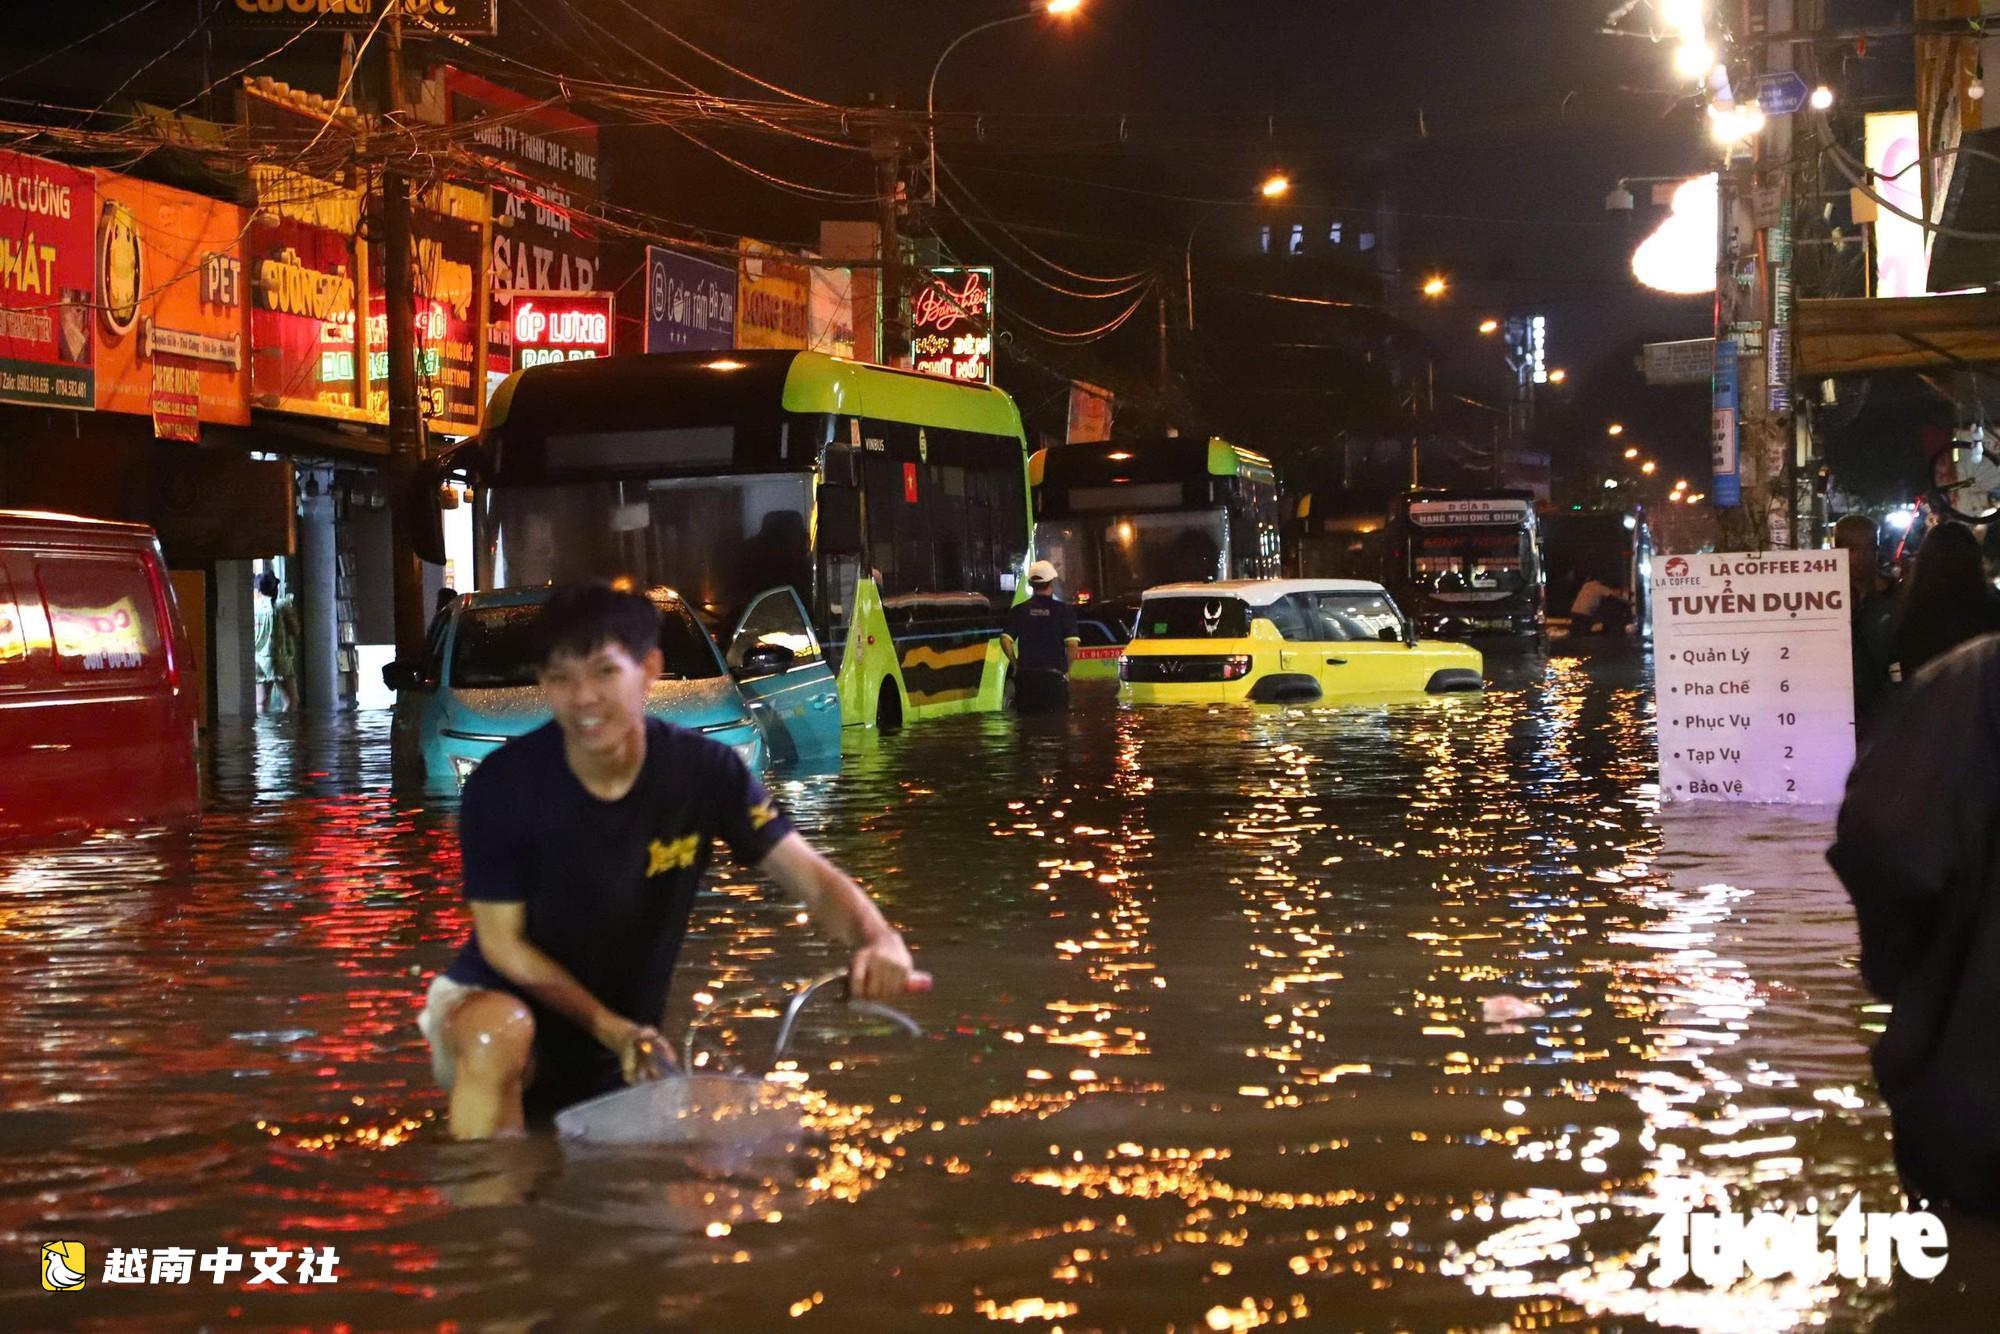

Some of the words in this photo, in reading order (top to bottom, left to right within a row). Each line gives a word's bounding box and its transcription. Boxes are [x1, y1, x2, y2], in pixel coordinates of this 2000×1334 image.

[504, 127, 517, 152] TY
[519, 132, 545, 164] TNHH
[546, 142, 560, 168] 3H
[575, 151, 597, 181] BIKE
[208, 253, 241, 305] PET
[864, 437, 885, 452] VINBUS
[1709, 563, 1730, 577] LA
[1734, 560, 1799, 576] COFFEE
[1803, 558, 1838, 573] 24H
[1655, 578, 1667, 587] LA
[1669, 577, 1700, 586] COFFEE
[1668, 580, 1756, 616] TUYỂN
[1763, 590, 1842, 618] DỤNG
[1683, 648, 1726, 665] Quản
[1731, 648, 1749, 664] Lý
[1780, 646, 1790, 660] 2
[1684, 682, 1714, 696] Pha
[1719, 679, 1750, 695] Chế
[1780, 679, 1790, 693] 6
[1685, 714, 1724, 732] Phục
[1730, 714, 1750, 730] Vụ
[1777, 712, 1796, 726] 10
[1687, 748, 1715, 765] Tạp
[1720, 748, 1740, 764] Vụ
[1784, 746, 1794, 759] 2
[1689, 779, 1718, 794] Bảo
[1723, 779, 1743, 796] Vệ
[1786, 779, 1796, 792] 2
